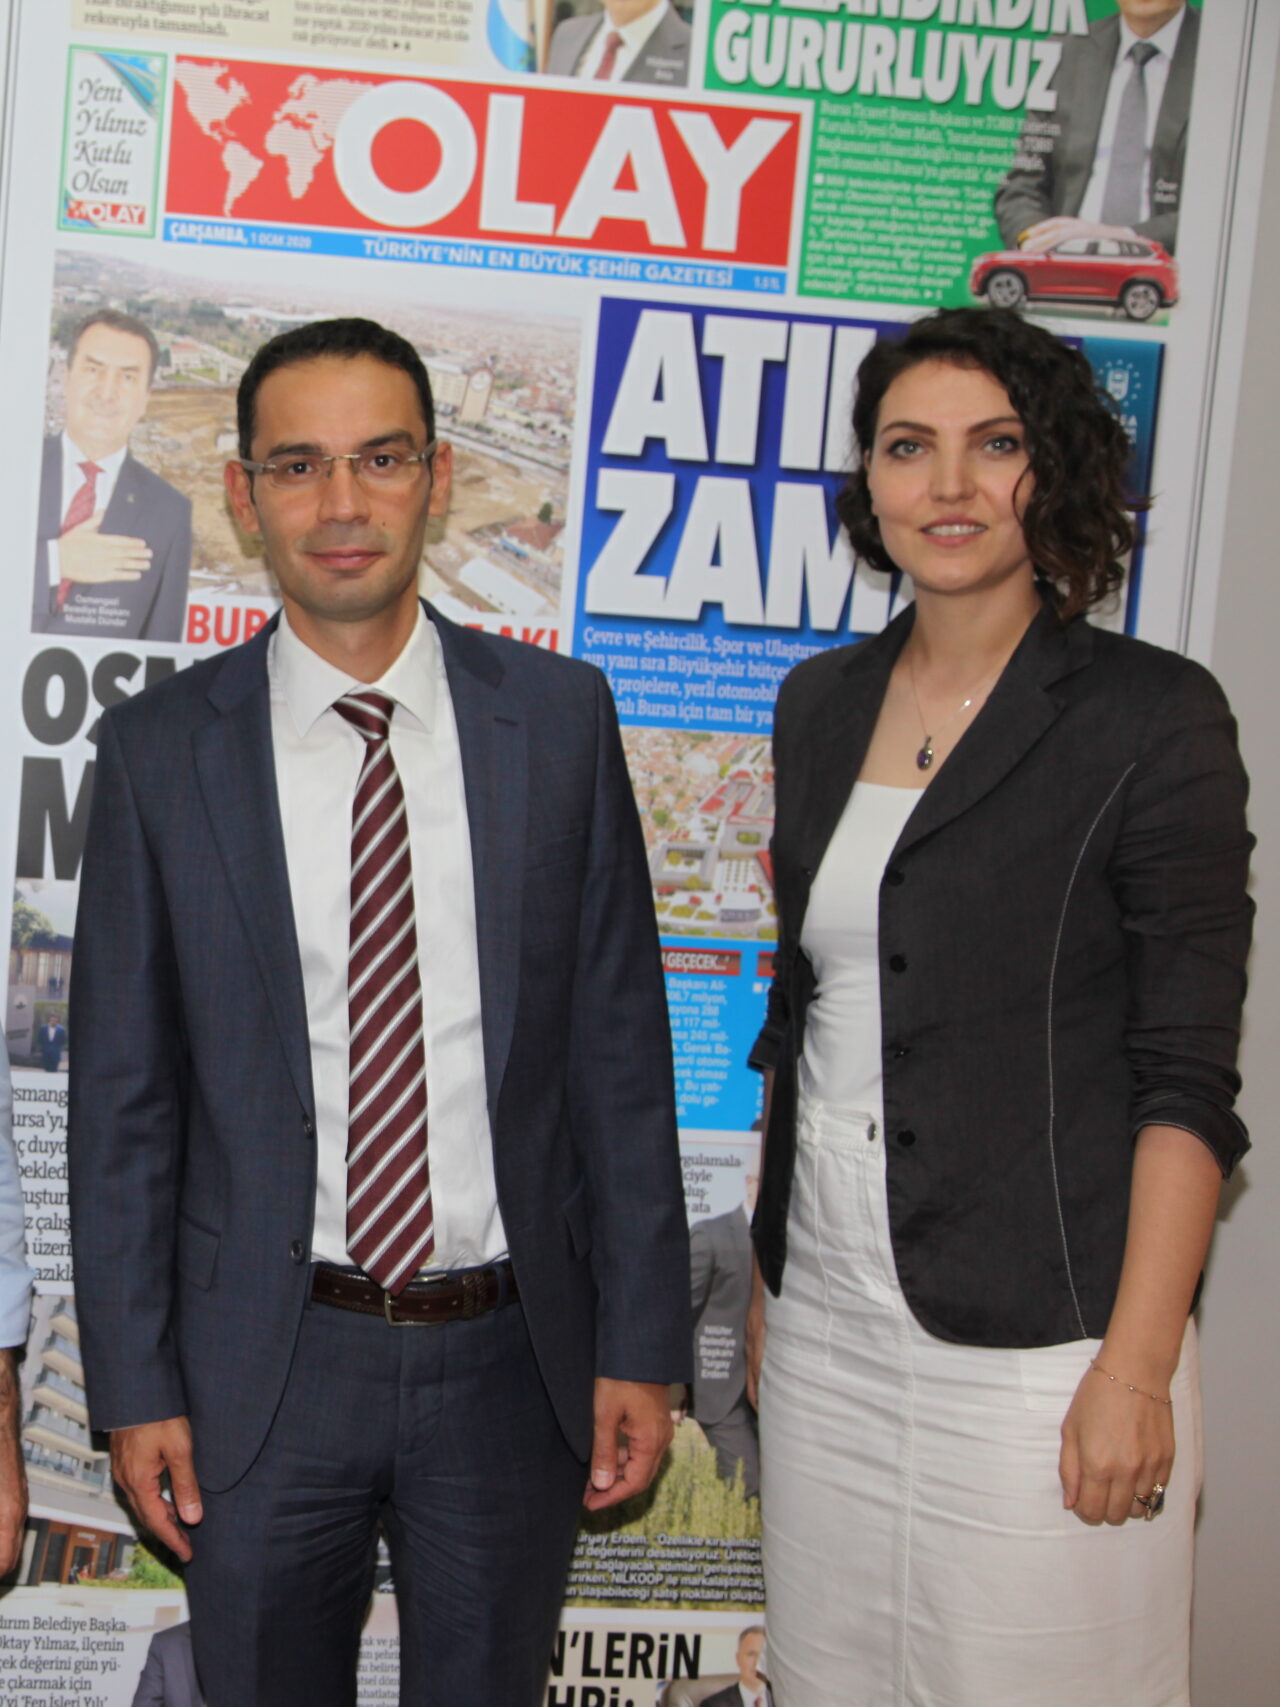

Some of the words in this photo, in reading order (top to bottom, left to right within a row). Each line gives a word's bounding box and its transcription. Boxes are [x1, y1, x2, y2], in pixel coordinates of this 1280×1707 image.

[713, 9, 1063, 112] GURURLUYUZ
[78, 78, 122, 105] Yeni
[73, 139, 132, 167] Kutlu
[332, 80, 794, 253] OLAY
[72, 168, 128, 195] Olsun
[89, 203, 145, 223] OLAY
[169, 221, 248, 245] ÇARŞAMBA,
[362, 238, 483, 265] TÜRKİYE'NİN
[489, 250, 515, 267] EN
[518, 251, 584, 274] BÜYÜK
[587, 256, 643, 278] ŞEHİR
[644, 263, 734, 287] GAZETESİ
[584, 467, 915, 634] ZAM
[584, 626, 624, 648] Çevre
[625, 632, 641, 647] ve
[644, 630, 711, 654] Şehircilik,
[713, 637, 747, 657] Spor
[747, 641, 763, 656] ve
[607, 654, 638, 672] yanı
[640, 657, 666, 671] sıra
[668, 658, 747, 682] Büyükşehir
[748, 660, 790, 684] bütçe
[617, 677, 681, 698] projelere,
[683, 681, 715, 699] yerli
[637, 699, 676, 718] Bursa
[677, 701, 704, 722] için
[706, 705, 732, 722] tam
[734, 705, 754, 723] bir
[11, 1088, 69, 1108] smang
[33, 1616, 87, 1634] Belediye
[89, 1617, 130, 1635] Başka-
[33, 1636, 79, 1653] Yılmaz,
[81, 1637, 125, 1655] ilçenin
[19, 1655, 71, 1673] değerini
[74, 1657, 98, 1674] gün
[101, 1657, 120, 1674] yü-
[7, 1675, 66, 1693] çıkarmak
[69, 1676, 92, 1695] için
